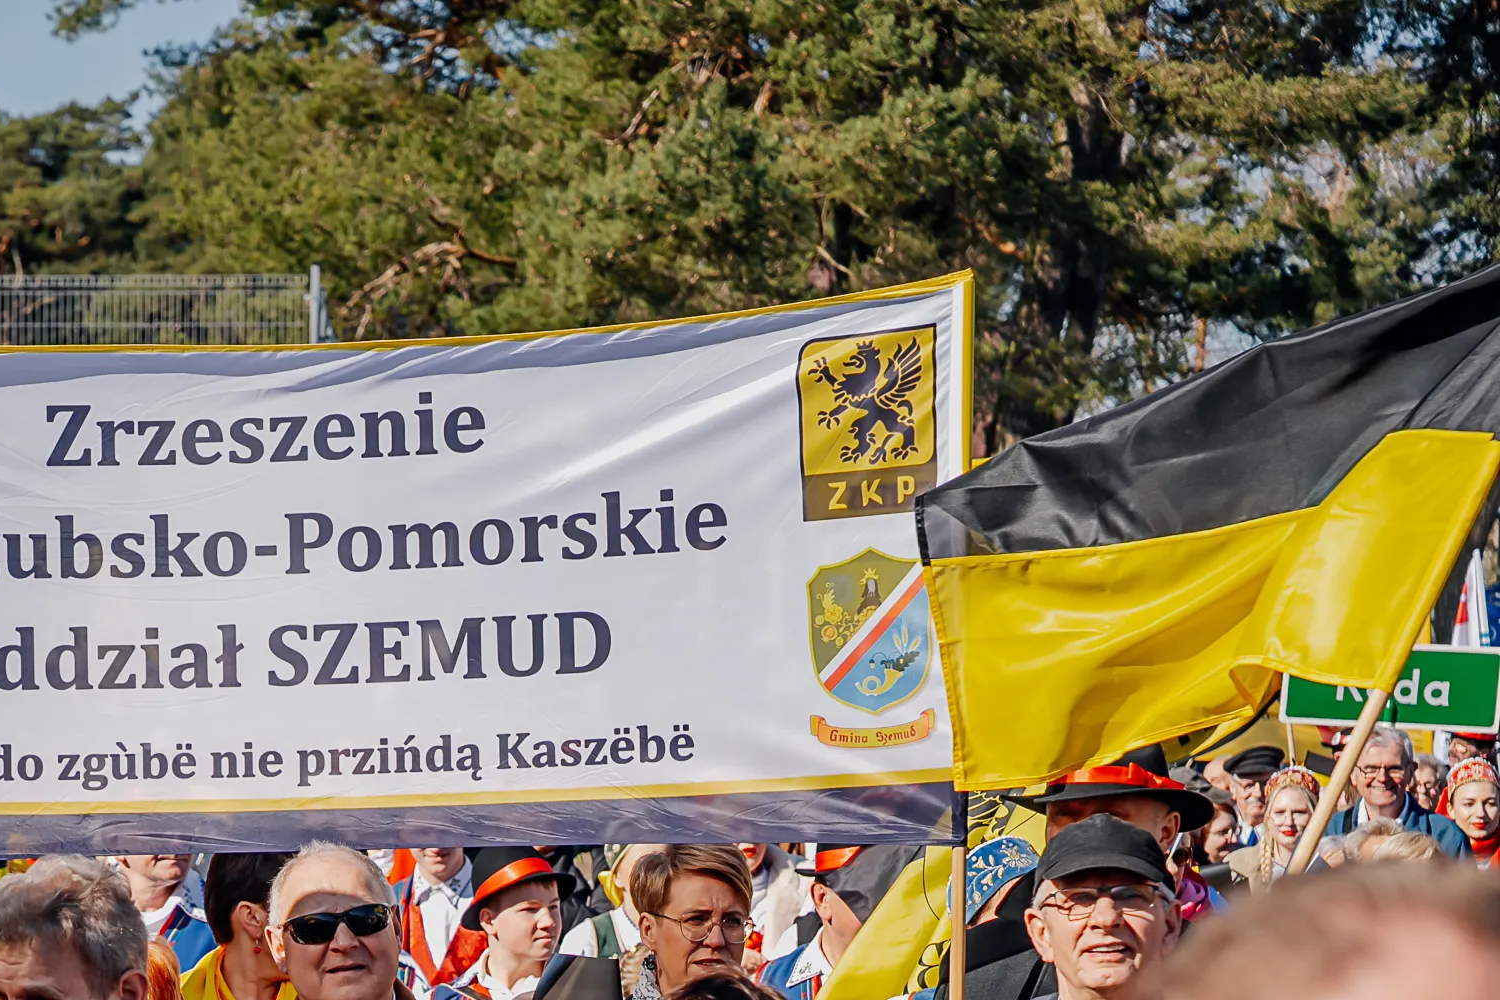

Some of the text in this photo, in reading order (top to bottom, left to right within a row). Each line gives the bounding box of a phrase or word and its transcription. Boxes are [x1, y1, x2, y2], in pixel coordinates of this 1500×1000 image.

[44, 392, 486, 468] Zrzeszenie
[827, 475, 916, 511] ZKP
[267, 611, 612, 687] SZEMUD
[1335, 668, 1451, 707] da
[57, 741, 197, 791] zgùbë
[210, 741, 284, 779] nie
[296, 734, 483, 787] przińdą
[496, 723, 695, 770] Kaszëbë
[829, 725, 917, 746] Gmina Szemud
